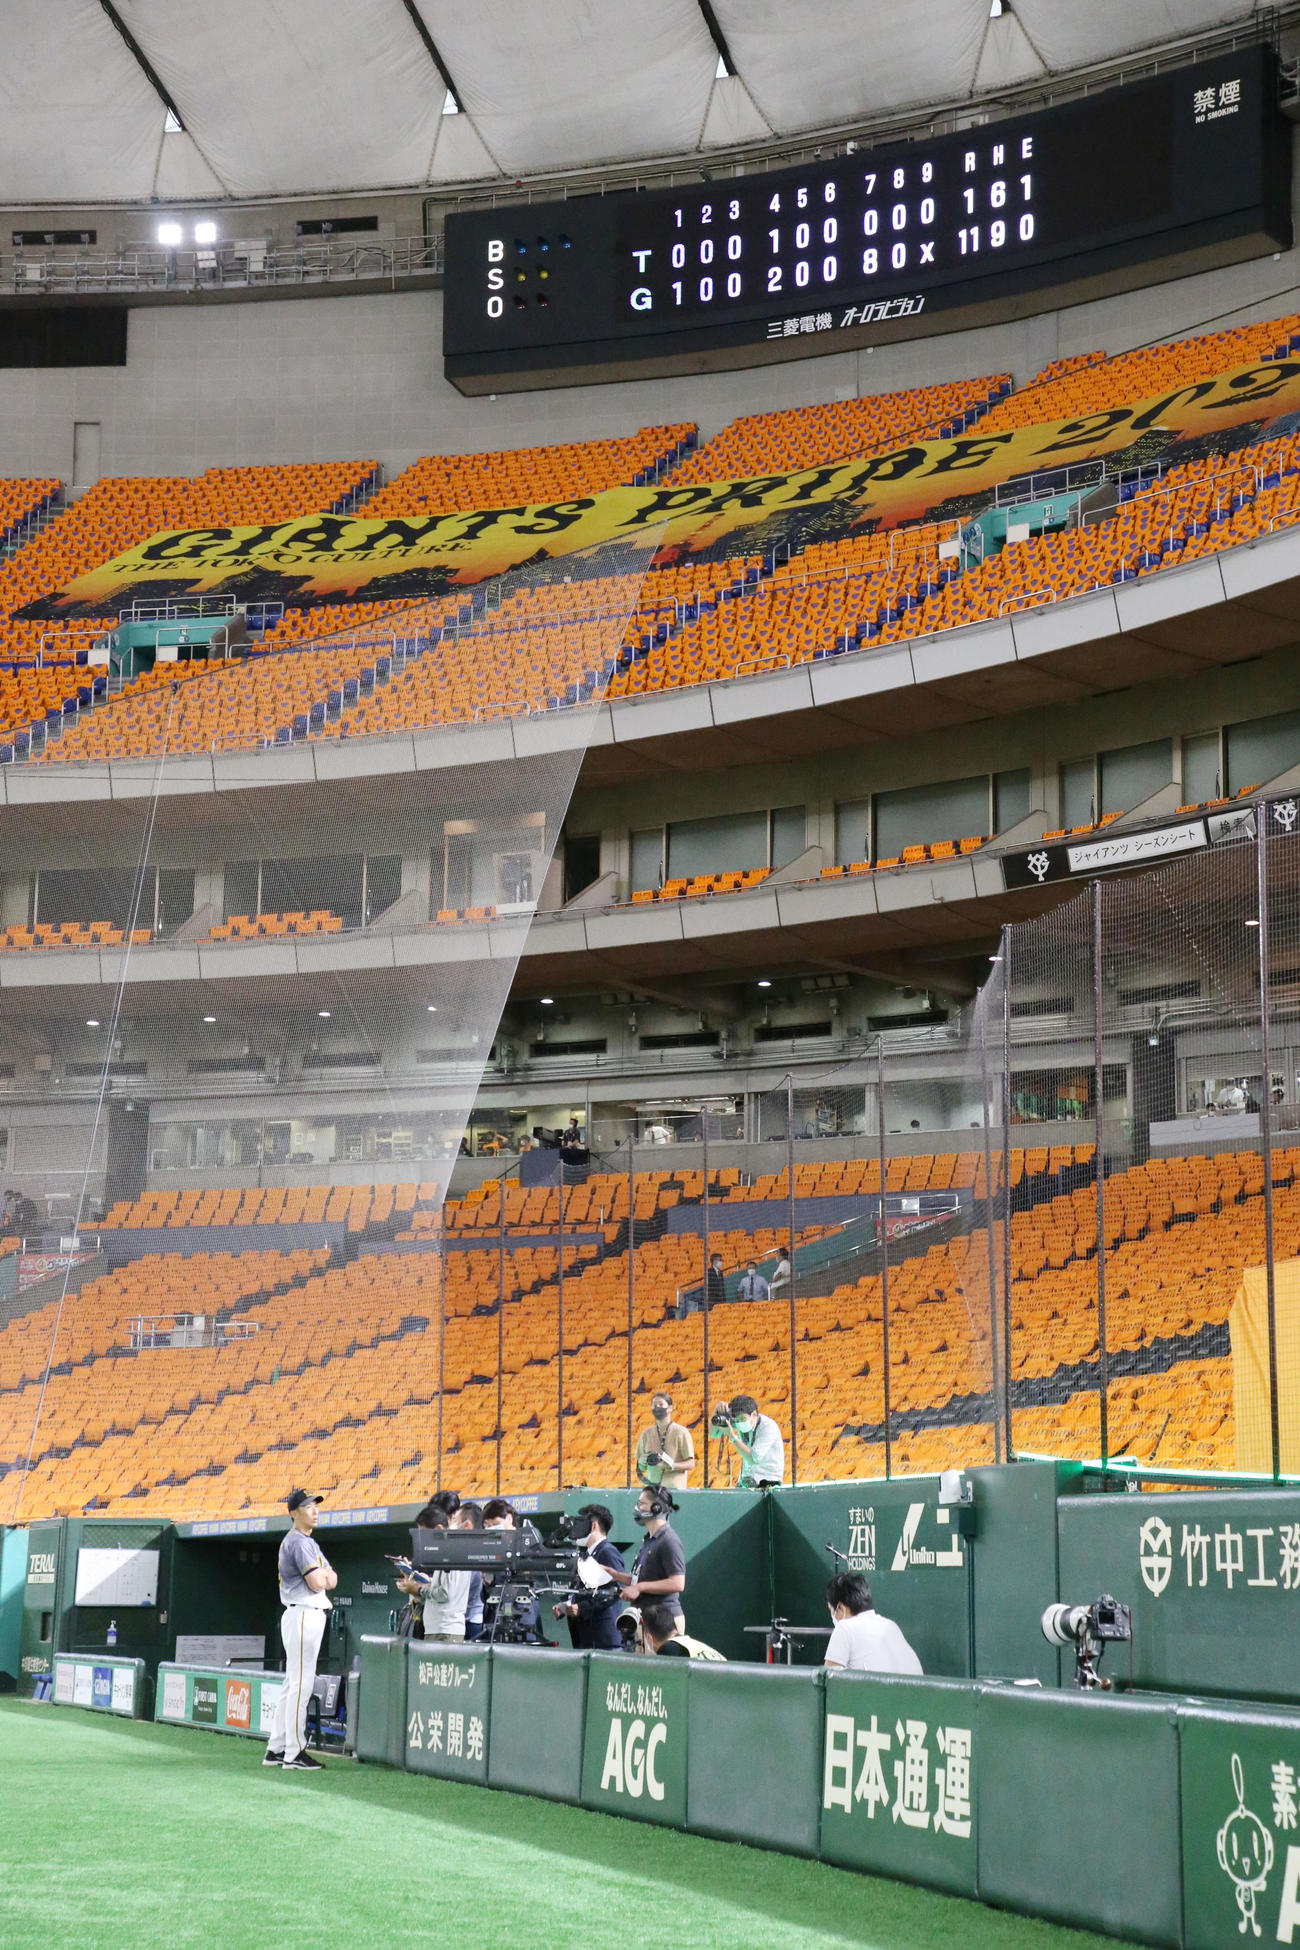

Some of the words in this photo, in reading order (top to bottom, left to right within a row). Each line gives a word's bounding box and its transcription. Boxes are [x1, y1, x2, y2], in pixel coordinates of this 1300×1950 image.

[1194, 79, 1241, 113] 禁煙
[1195, 115, 1205, 124] NO
[1207, 105, 1239, 120] SMOKING
[674, 209, 682, 228] 1
[702, 205, 712, 224] 2
[729, 200, 740, 219] 3
[769, 193, 781, 213] 4
[798, 188, 808, 208] 5
[825, 183, 836, 203] 6
[865, 174, 877, 195] 7
[893, 168, 905, 189] 8
[921, 162, 933, 183] 9
[965, 152, 976, 173] R
[993, 144, 1005, 166] H
[1022, 137, 1033, 159] E
[632, 250, 652, 273] T
[672, 244, 686, 269] 0
[701, 239, 714, 264] 0
[728, 235, 742, 260] 0
[769, 228, 779, 254] 1
[796, 223, 810, 249] 0
[824, 218, 838, 244] 0
[864, 210, 879, 236] 0
[892, 204, 907, 231] 0
[921, 198, 935, 225] 0
[963, 188, 974, 214] 1
[991, 181, 1006, 208] 6
[1020, 174, 1031, 201] 1
[488, 240, 505, 263] B
[631, 288, 653, 311] G
[672, 281, 682, 306] 1
[700, 276, 714, 302] 0
[728, 272, 742, 298] 0
[768, 267, 783, 293] 2
[796, 262, 810, 287] 0
[823, 256, 838, 282] 0
[863, 248, 879, 275] 8
[892, 243, 907, 269] 0
[958, 226, 980, 255] 11
[991, 220, 1006, 248] 9
[1020, 213, 1035, 241] 0
[488, 268, 505, 291] S
[766, 312, 833, 339] 三菱電機
[141, 498, 597, 560] GIANTS
[615, 432, 1014, 527] PRIDE
[113, 561, 184, 573] THE
[193, 552, 302, 569] TOKO
[308, 541, 472, 563] CULTURE
[1073, 842, 1130, 864] ジャイアンツ
[1134, 829, 1197, 852] シーズンシート
[848, 1506, 875, 1524] すまいの
[848, 1524, 876, 1557] ZEN
[30, 1554, 55, 1573] TERAL
[848, 1557, 876, 1571] HOLDINGS
[418, 1660, 476, 1689] 松戸公産グループ
[605, 1681, 668, 1720] なんだし、なんだし、
[408, 1711, 484, 1761] 公栄開発
[600, 1717, 667, 1801] AGC
[823, 1713, 972, 1839] 日本通運
[1270, 1760, 1300, 1831] 素
